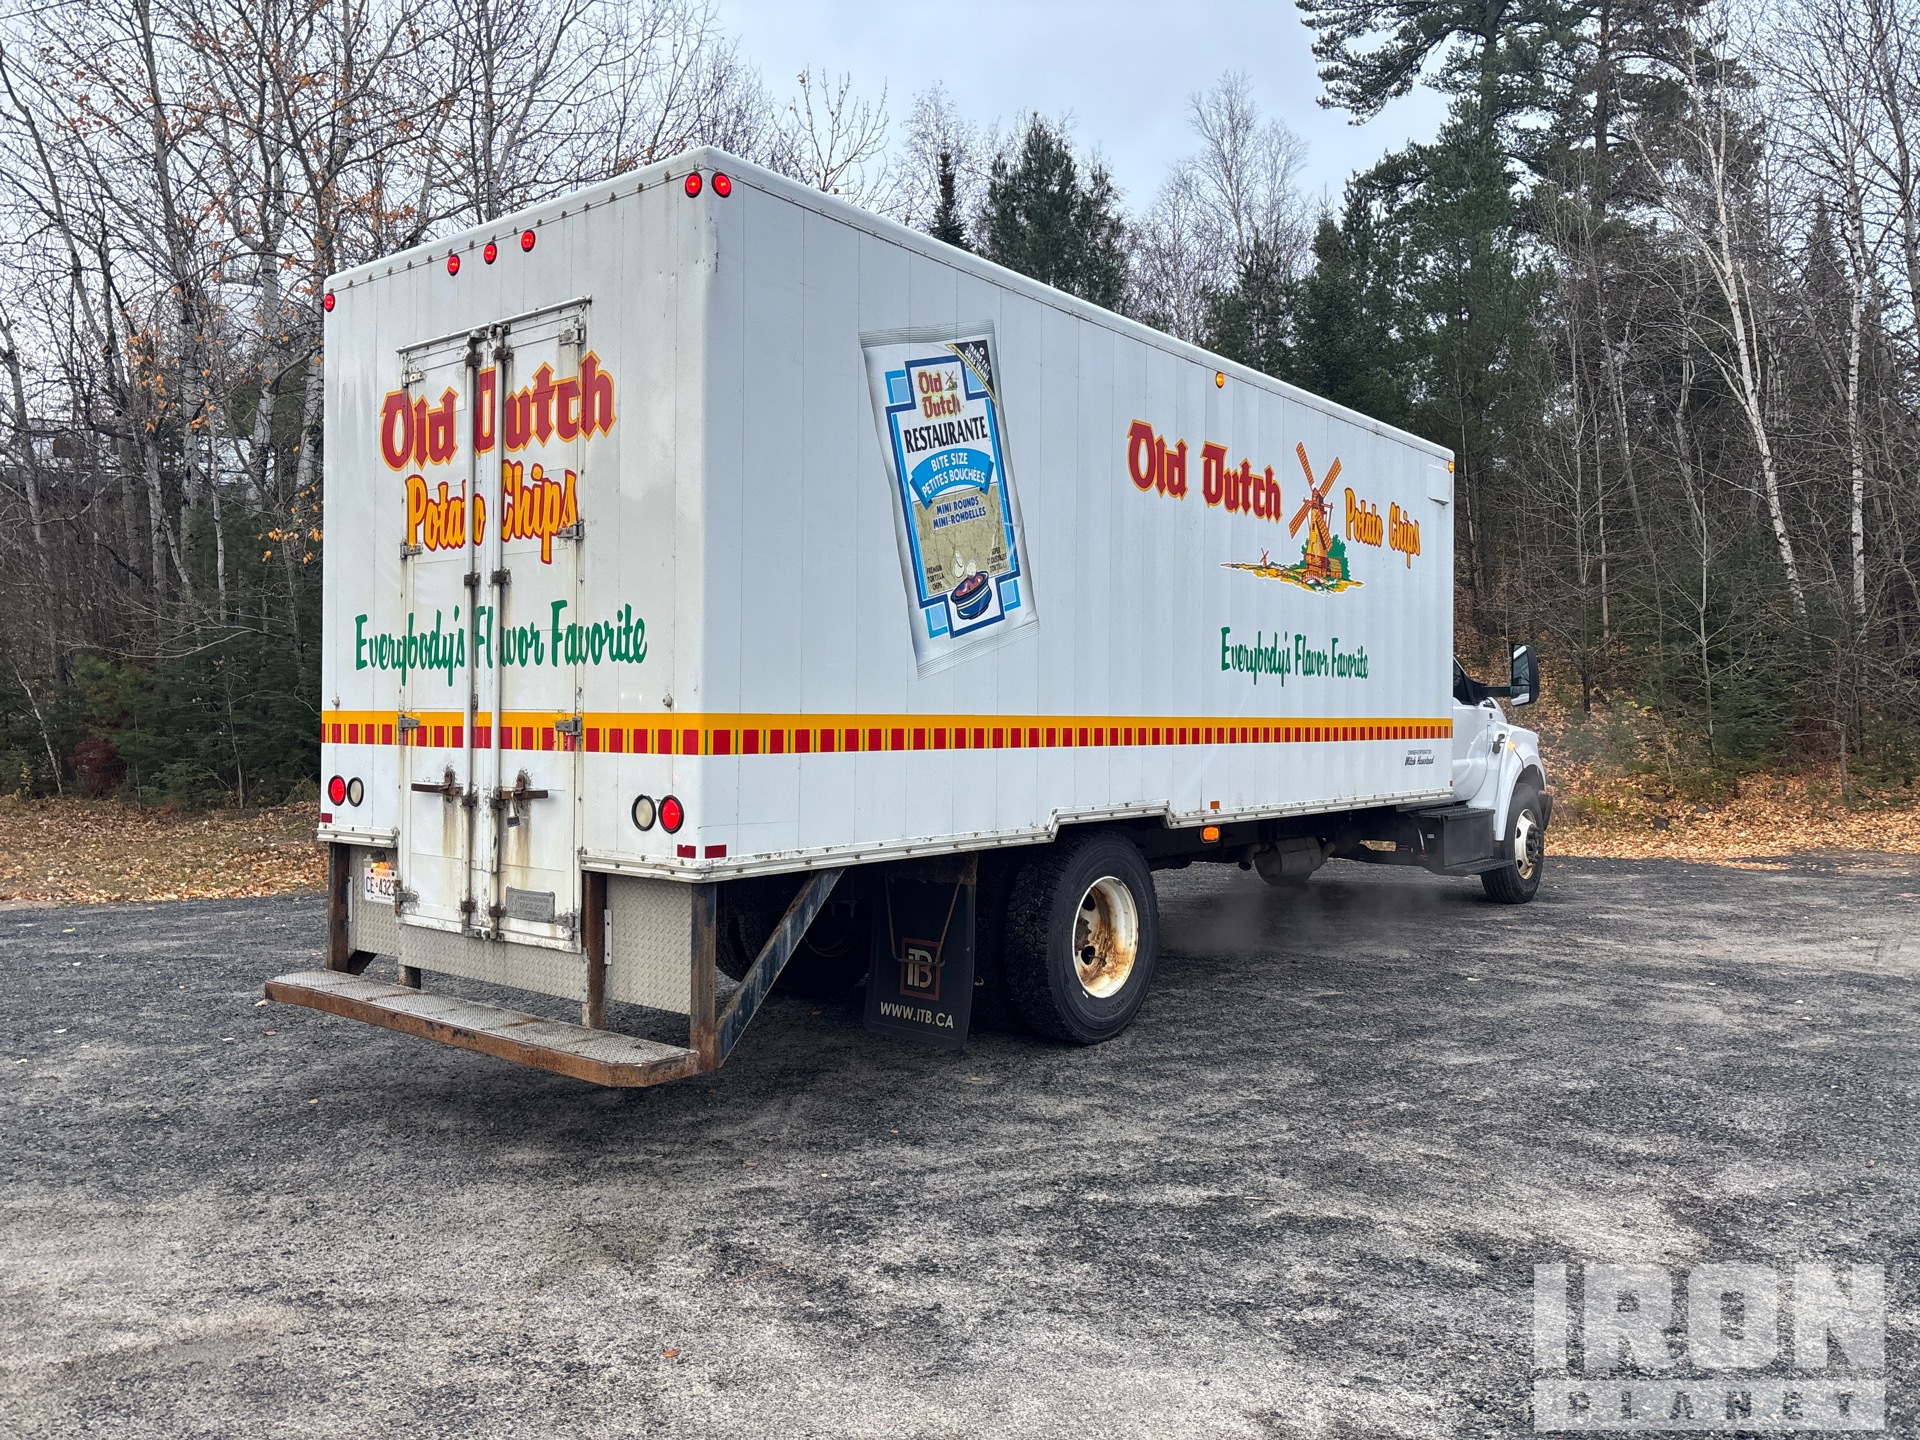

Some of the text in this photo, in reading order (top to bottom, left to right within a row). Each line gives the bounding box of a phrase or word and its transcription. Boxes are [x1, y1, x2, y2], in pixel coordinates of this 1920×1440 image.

[917, 369, 943, 395] Old
[380, 350, 617, 471] Old Dutch
[921, 392, 962, 420] Dutch
[903, 416, 988, 453] RESTAURANTE
[931, 452, 968, 472] BITE SIZE
[1127, 418, 1282, 524] Old Dutch
[921, 467, 986, 498] PETITES BOUCHÉES
[502, 458, 578, 565] Chips
[933, 506, 987, 530] MINI-RONDELLES
[936, 496, 979, 515] MINI ROUNDS
[1344, 487, 1421, 569] Potato Chips
[355, 605, 465, 687] Everybody's
[550, 599, 647, 668] Favorite
[1220, 626, 1369, 688] Everybody's Flavor Favorite
[366, 876, 375, 893] CE
[880, 1001, 955, 1029] WWW.ITB.CA
